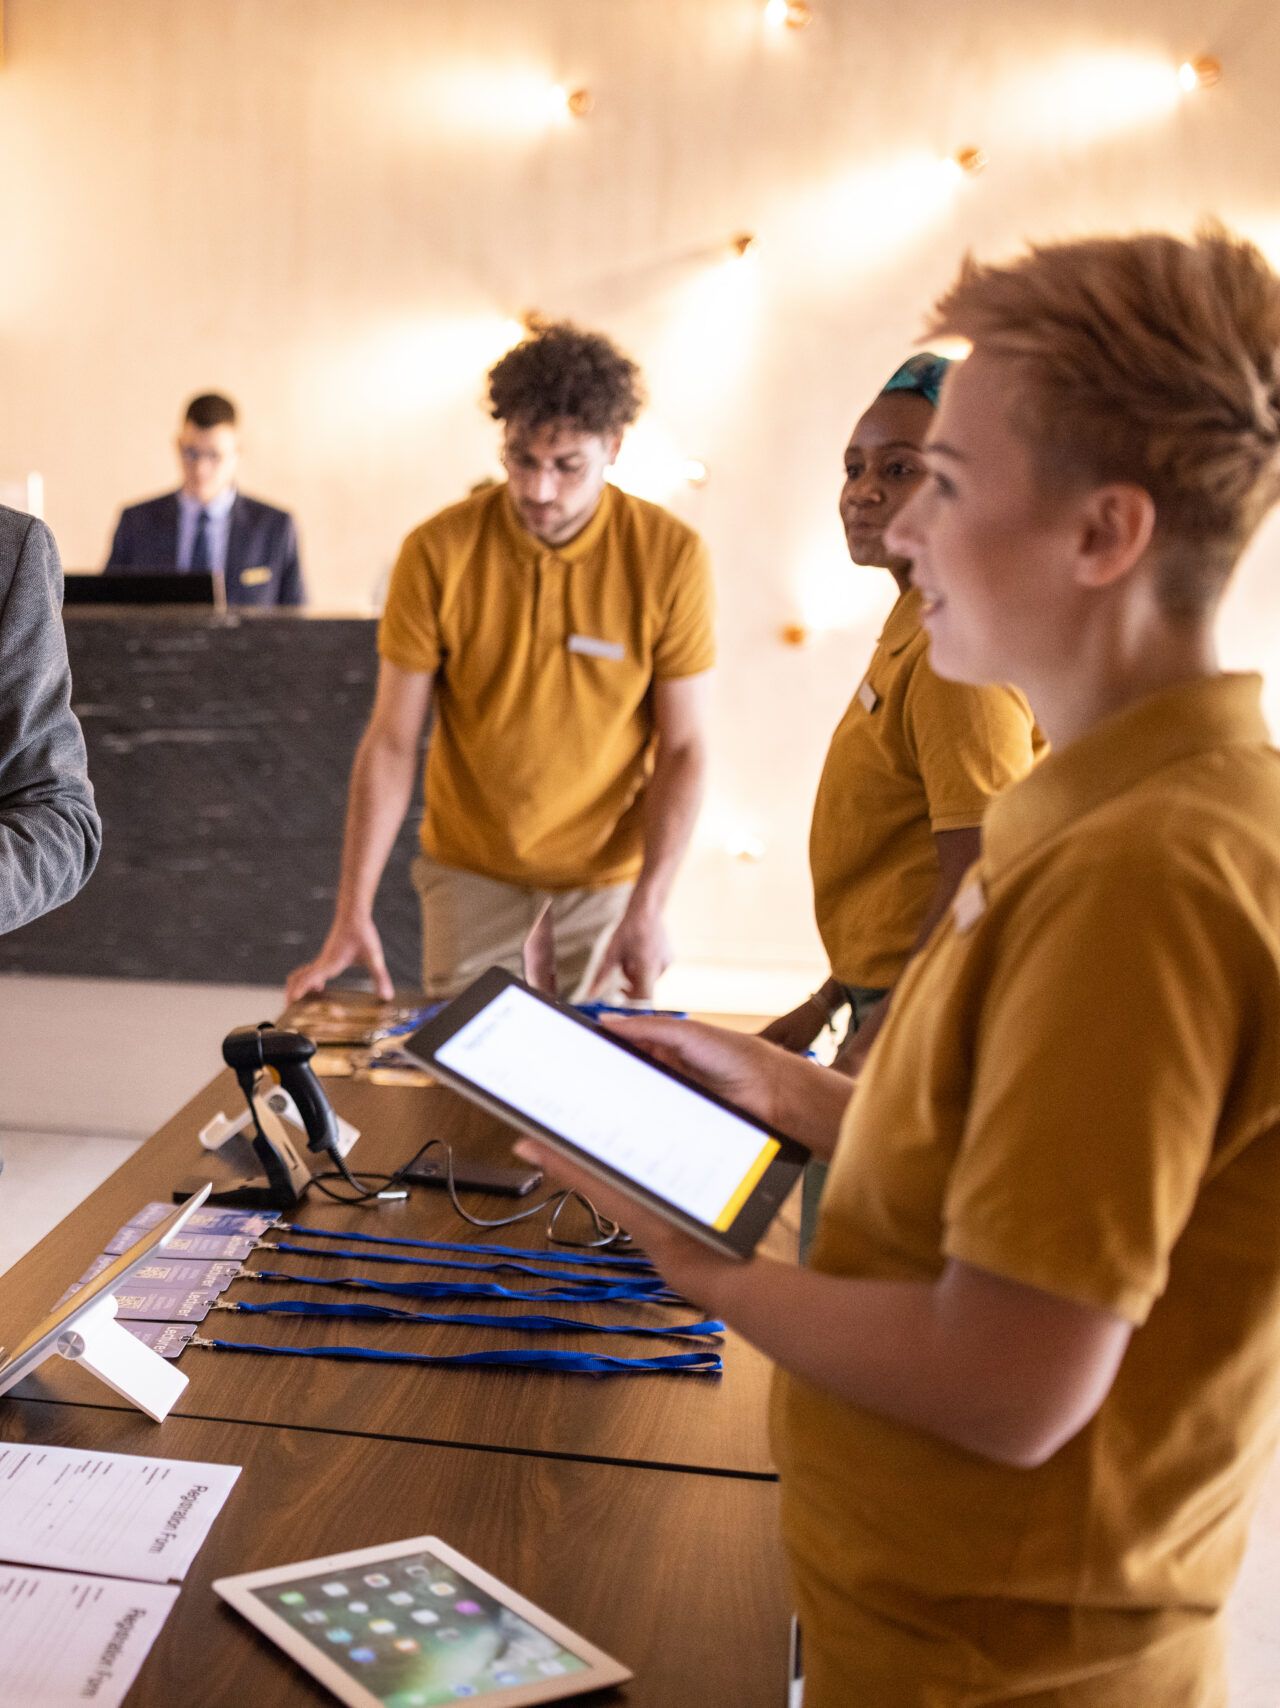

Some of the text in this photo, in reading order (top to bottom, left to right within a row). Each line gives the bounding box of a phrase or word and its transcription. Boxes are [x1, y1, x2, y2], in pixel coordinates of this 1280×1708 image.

[201, 1263, 231, 1288] Lecturer
[176, 1291, 209, 1317] Lecturer
[148, 1484, 209, 1554] Registration Form
[99, 1607, 147, 1667] Registration
